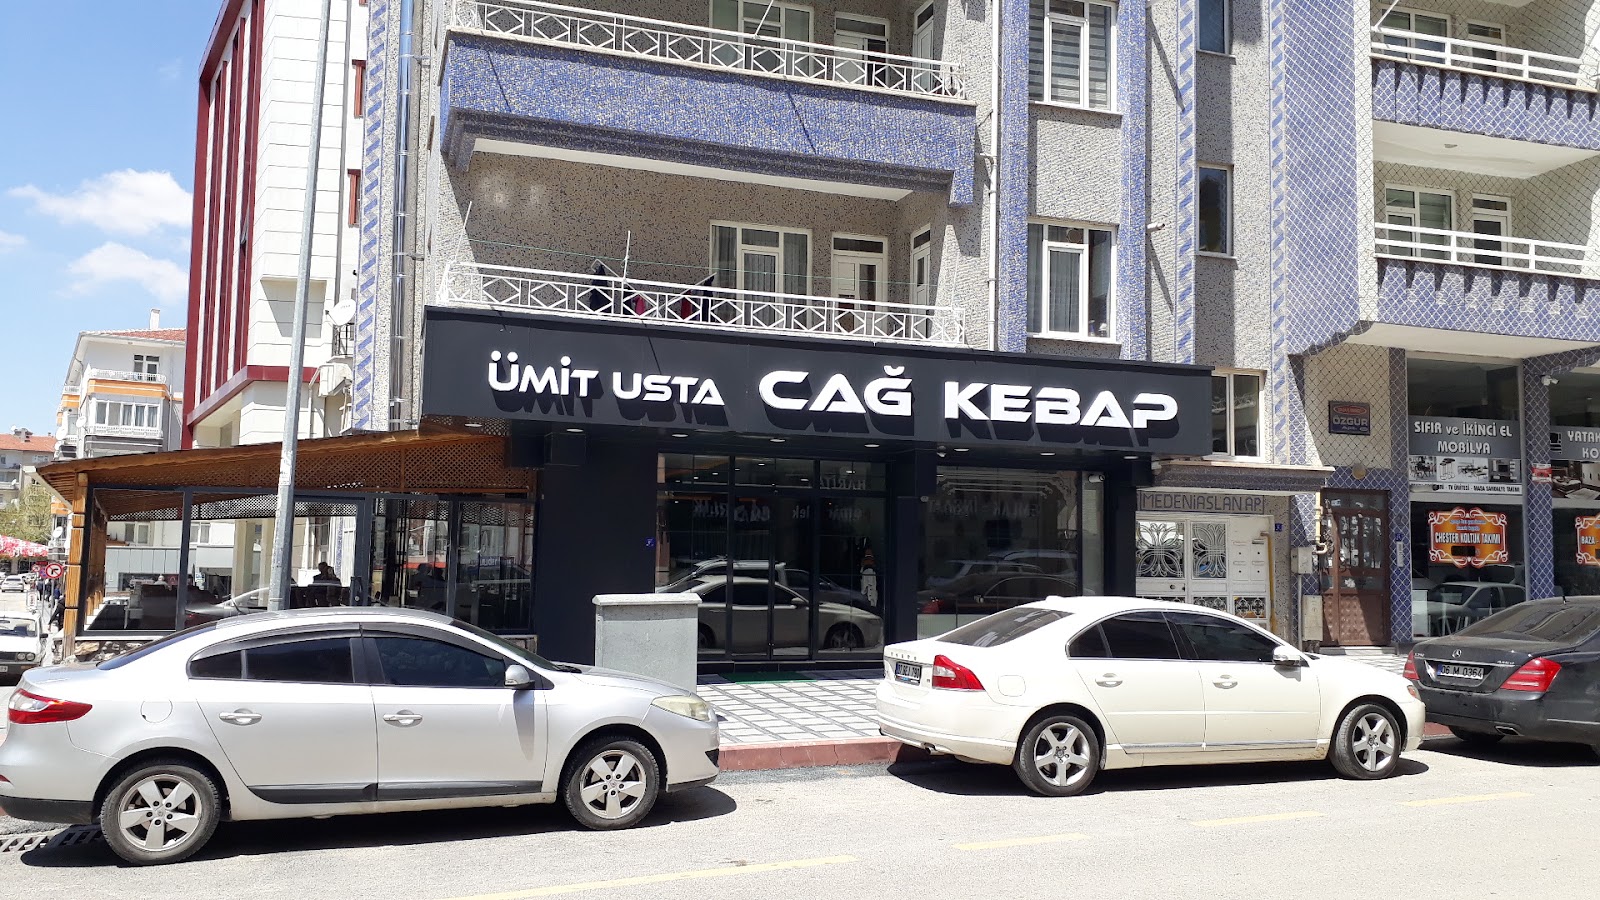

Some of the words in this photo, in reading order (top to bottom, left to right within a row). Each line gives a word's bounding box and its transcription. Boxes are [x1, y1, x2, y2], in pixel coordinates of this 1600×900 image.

[488, 350, 599, 397] ÜMİT
[612, 371, 725, 406] USTA
[758, 365, 913, 417] CAĞ
[944, 381, 1179, 429] KEBAP
[1332, 414, 1368, 426] ÖZGÜR
[1414, 421, 1442, 434] SIFIR
[1446, 426, 1459, 435] ve
[1462, 421, 1496, 437] İKİNCİ
[1500, 425, 1512, 437] EL
[1437, 440, 1491, 454] MOBİLYA
[1435, 533, 1459, 543] CHESTER
[1460, 533, 1480, 544] KOLTUK
[1581, 536, 1595, 544] BAZA
[1453, 667, 1460, 675] M
[1462, 667, 1483, 678] 0364
